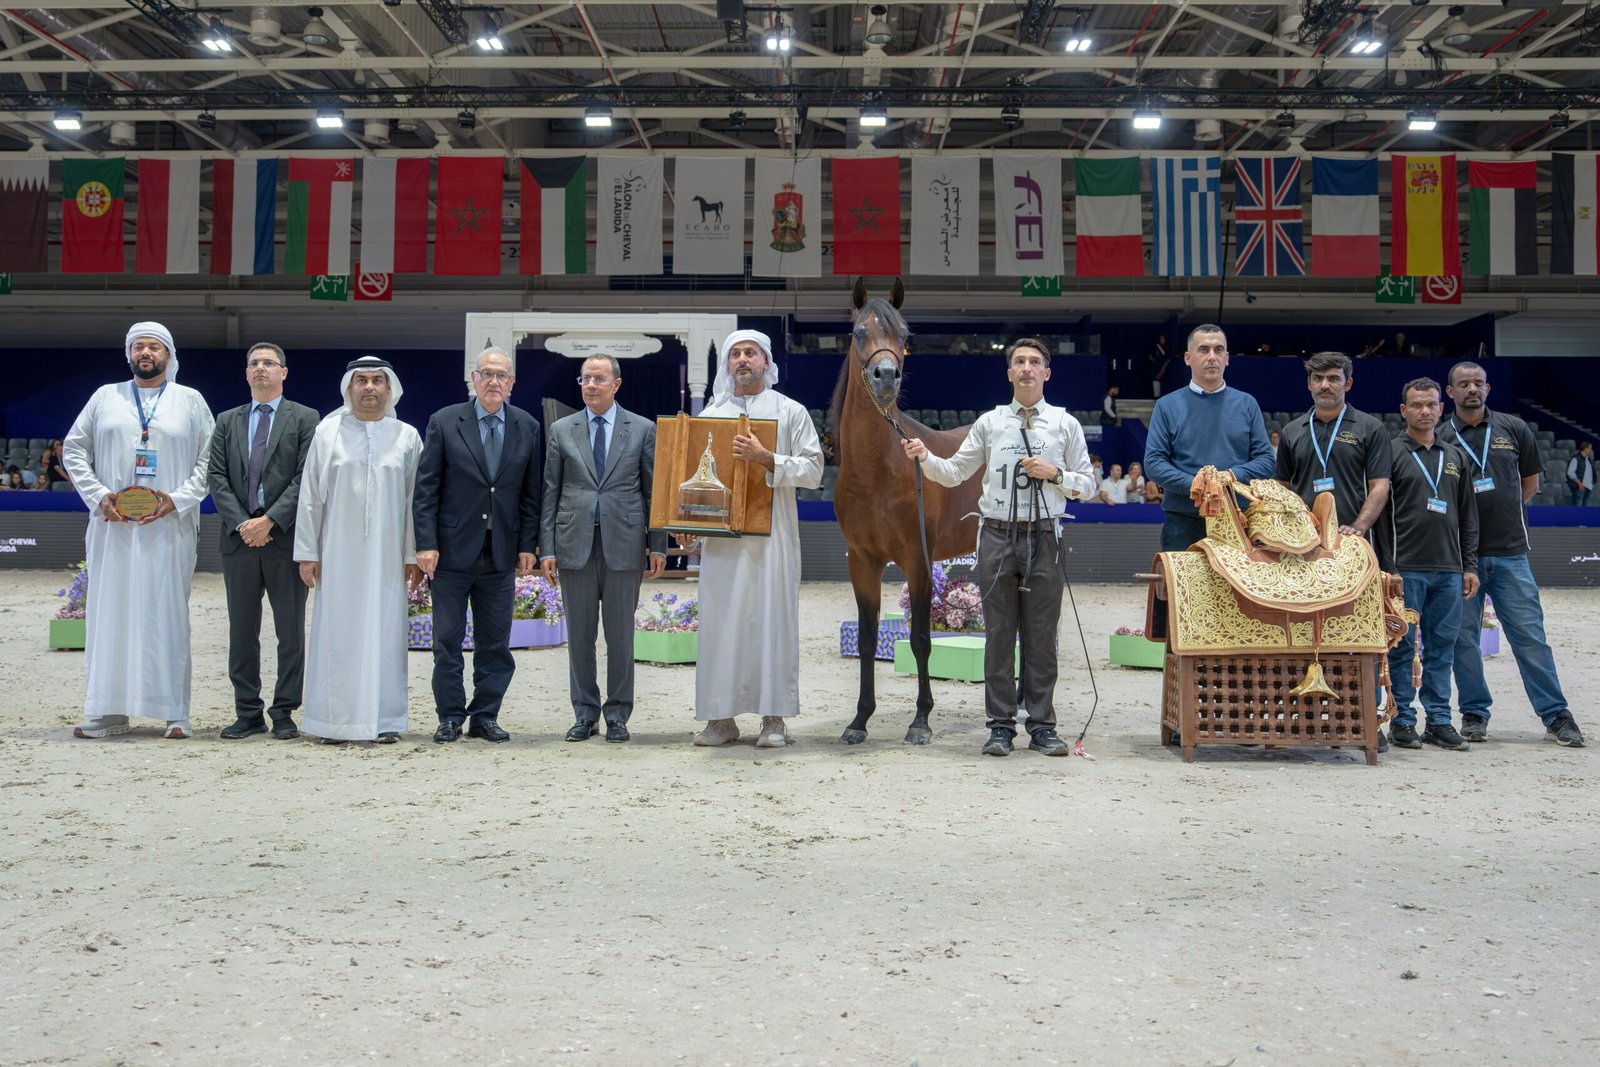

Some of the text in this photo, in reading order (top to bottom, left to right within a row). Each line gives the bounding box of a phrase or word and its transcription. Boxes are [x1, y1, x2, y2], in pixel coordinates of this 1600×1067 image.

[613, 197, 623, 234] JADIDA
[1014, 169, 1044, 260] FEI
[685, 223, 730, 231] ECAHO
[622, 223, 632, 262] CHEVAL
[8, 538, 38, 546] CHEVAL
[951, 558, 977, 566] JADID
